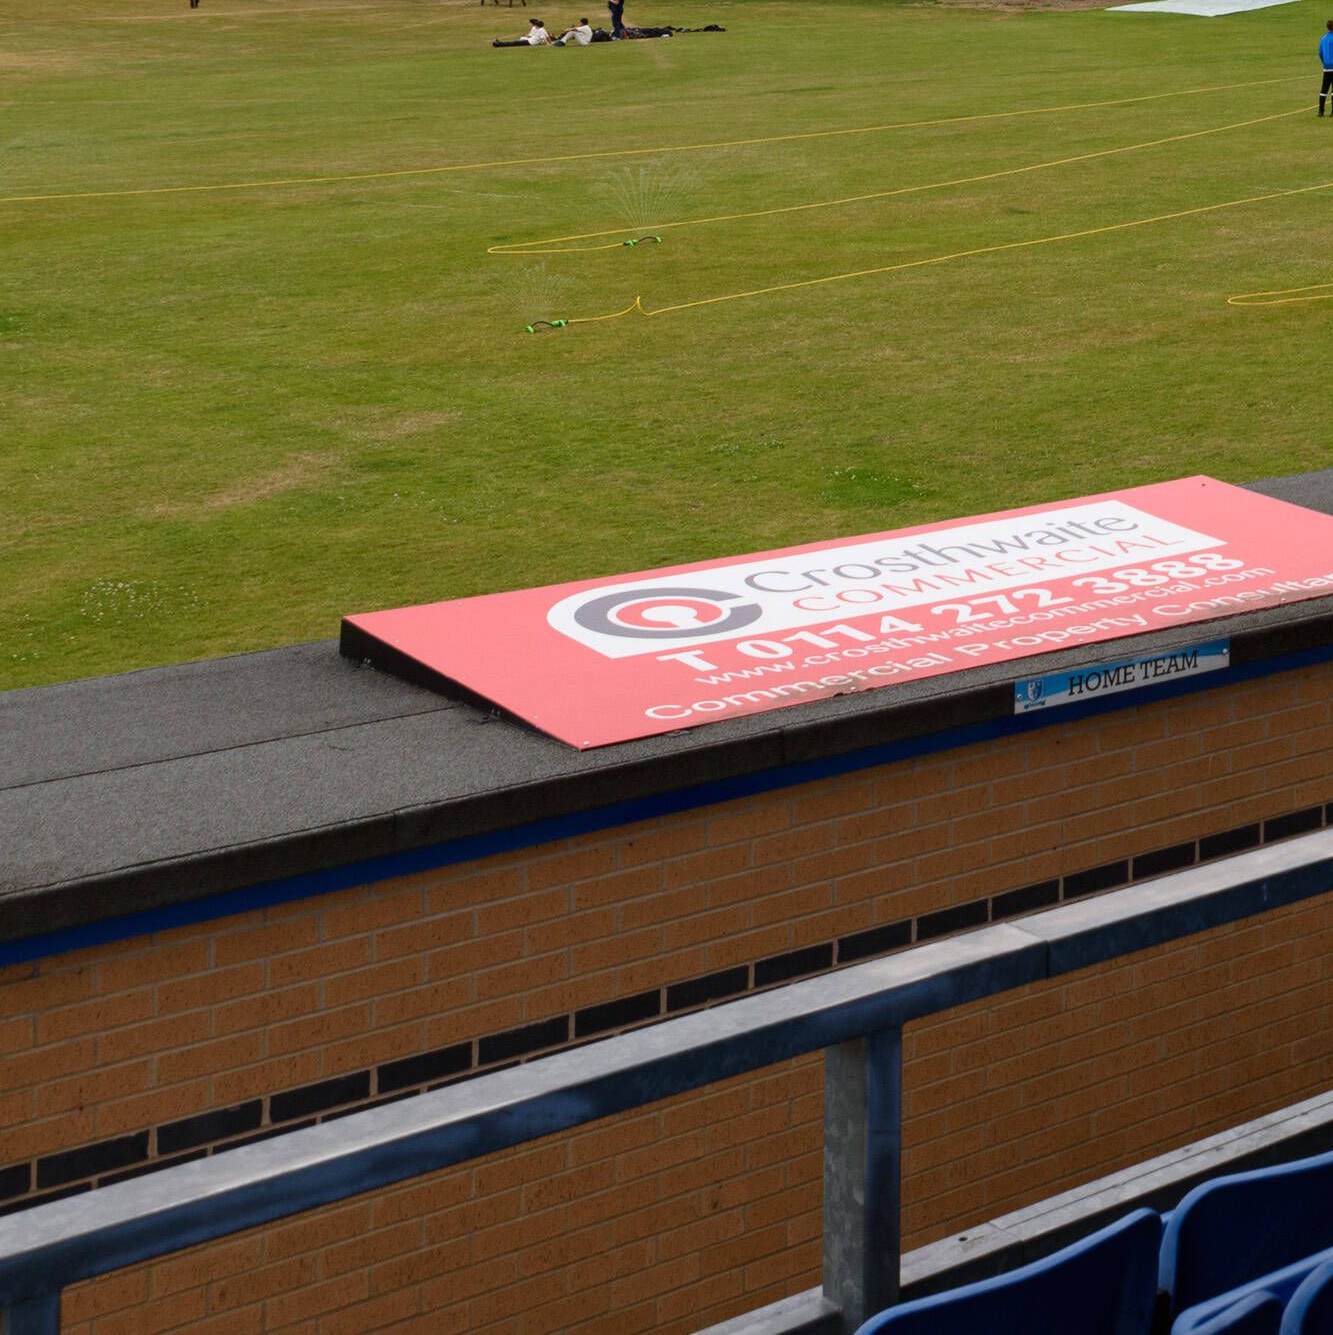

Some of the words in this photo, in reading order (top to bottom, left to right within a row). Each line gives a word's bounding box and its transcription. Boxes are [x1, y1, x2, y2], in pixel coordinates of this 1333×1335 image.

[743, 514, 1140, 595] Crosthwaite
[792, 532, 1186, 612] COMMERCIAL
[656, 648, 719, 673] T
[735, 614, 926, 659] 0114
[930, 587, 1077, 624] 272
[1072, 552, 1245, 596] 3888
[693, 565, 1277, 687] www.crosthwaitecommercial.com
[644, 652, 954, 720] Commercial
[953, 610, 1148, 658] Property
[1067, 664, 1137, 696] HOME
[1139, 649, 1200, 681] TEAM
